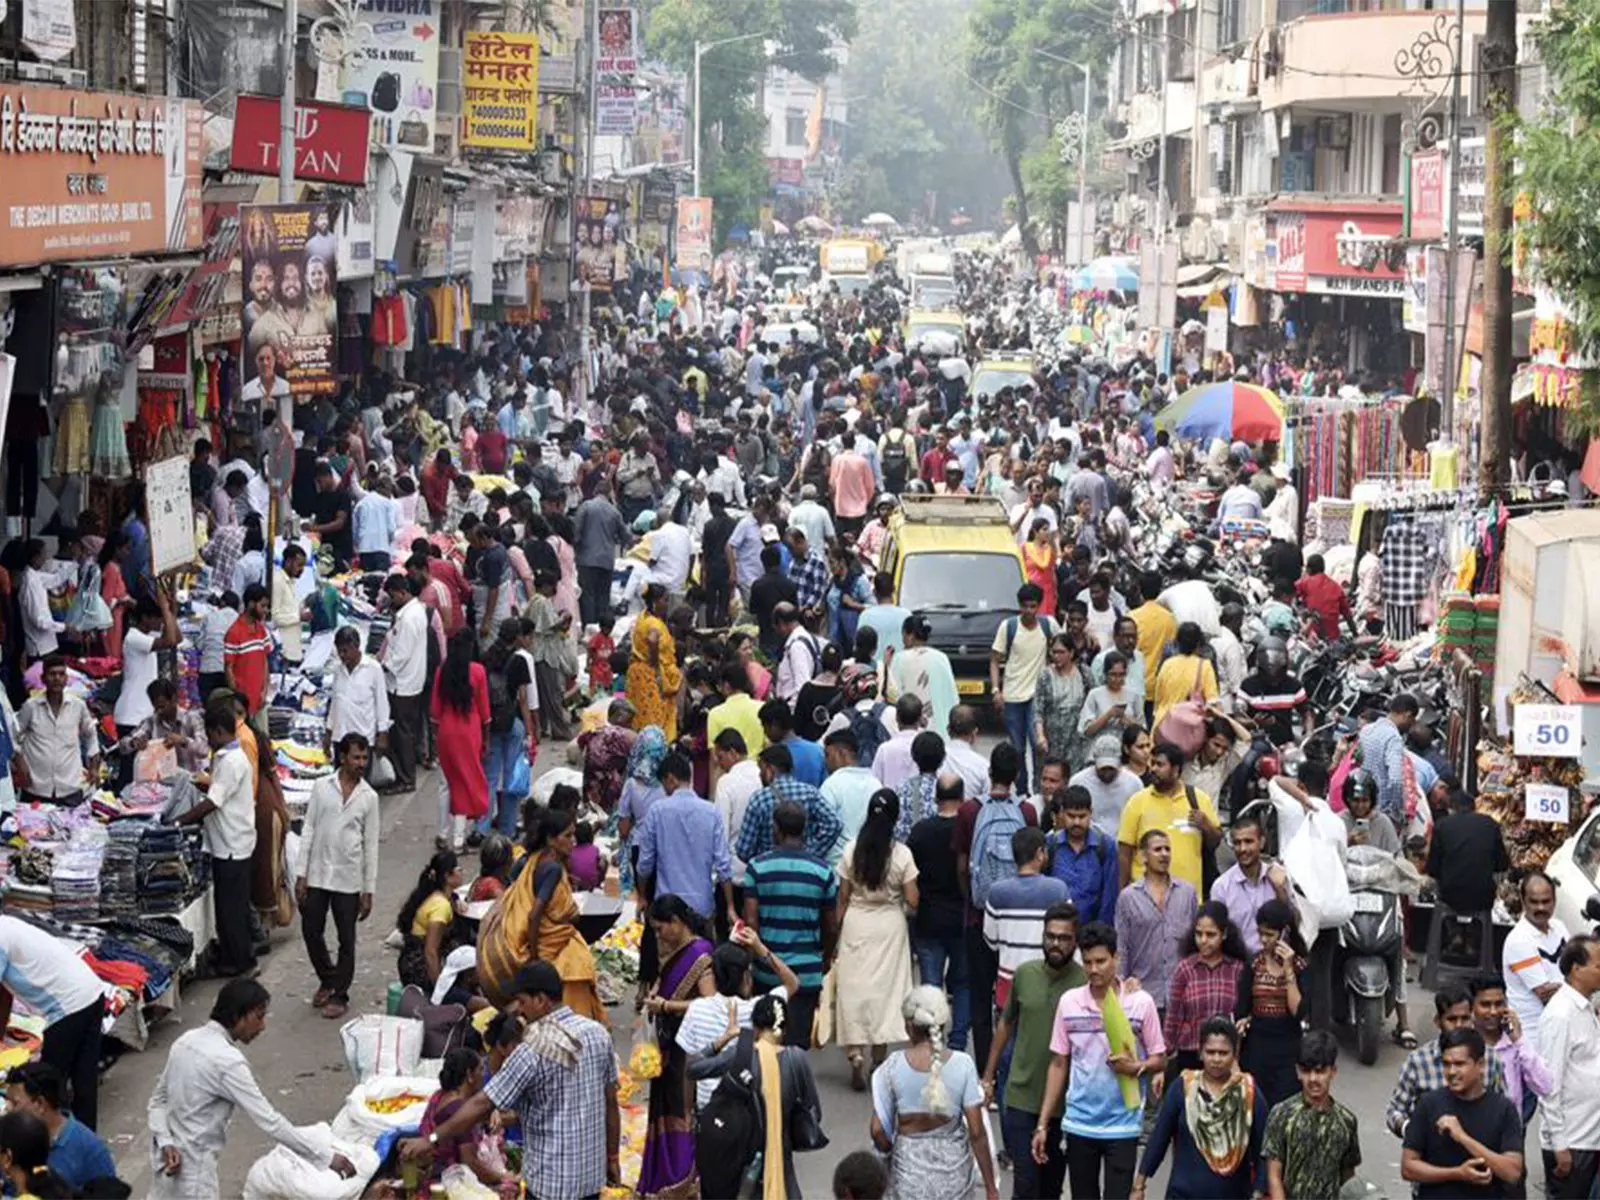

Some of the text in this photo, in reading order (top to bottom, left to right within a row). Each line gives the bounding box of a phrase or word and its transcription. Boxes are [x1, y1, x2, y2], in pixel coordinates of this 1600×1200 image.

[468, 34, 533, 60] हॉटेल
[465, 60, 533, 84] मनहर
[259, 143, 340, 175] TIAN
[1350, 279, 1389, 292] BRANDS
[1537, 724, 1569, 744] 50
[1540, 798, 1561, 814] 50
